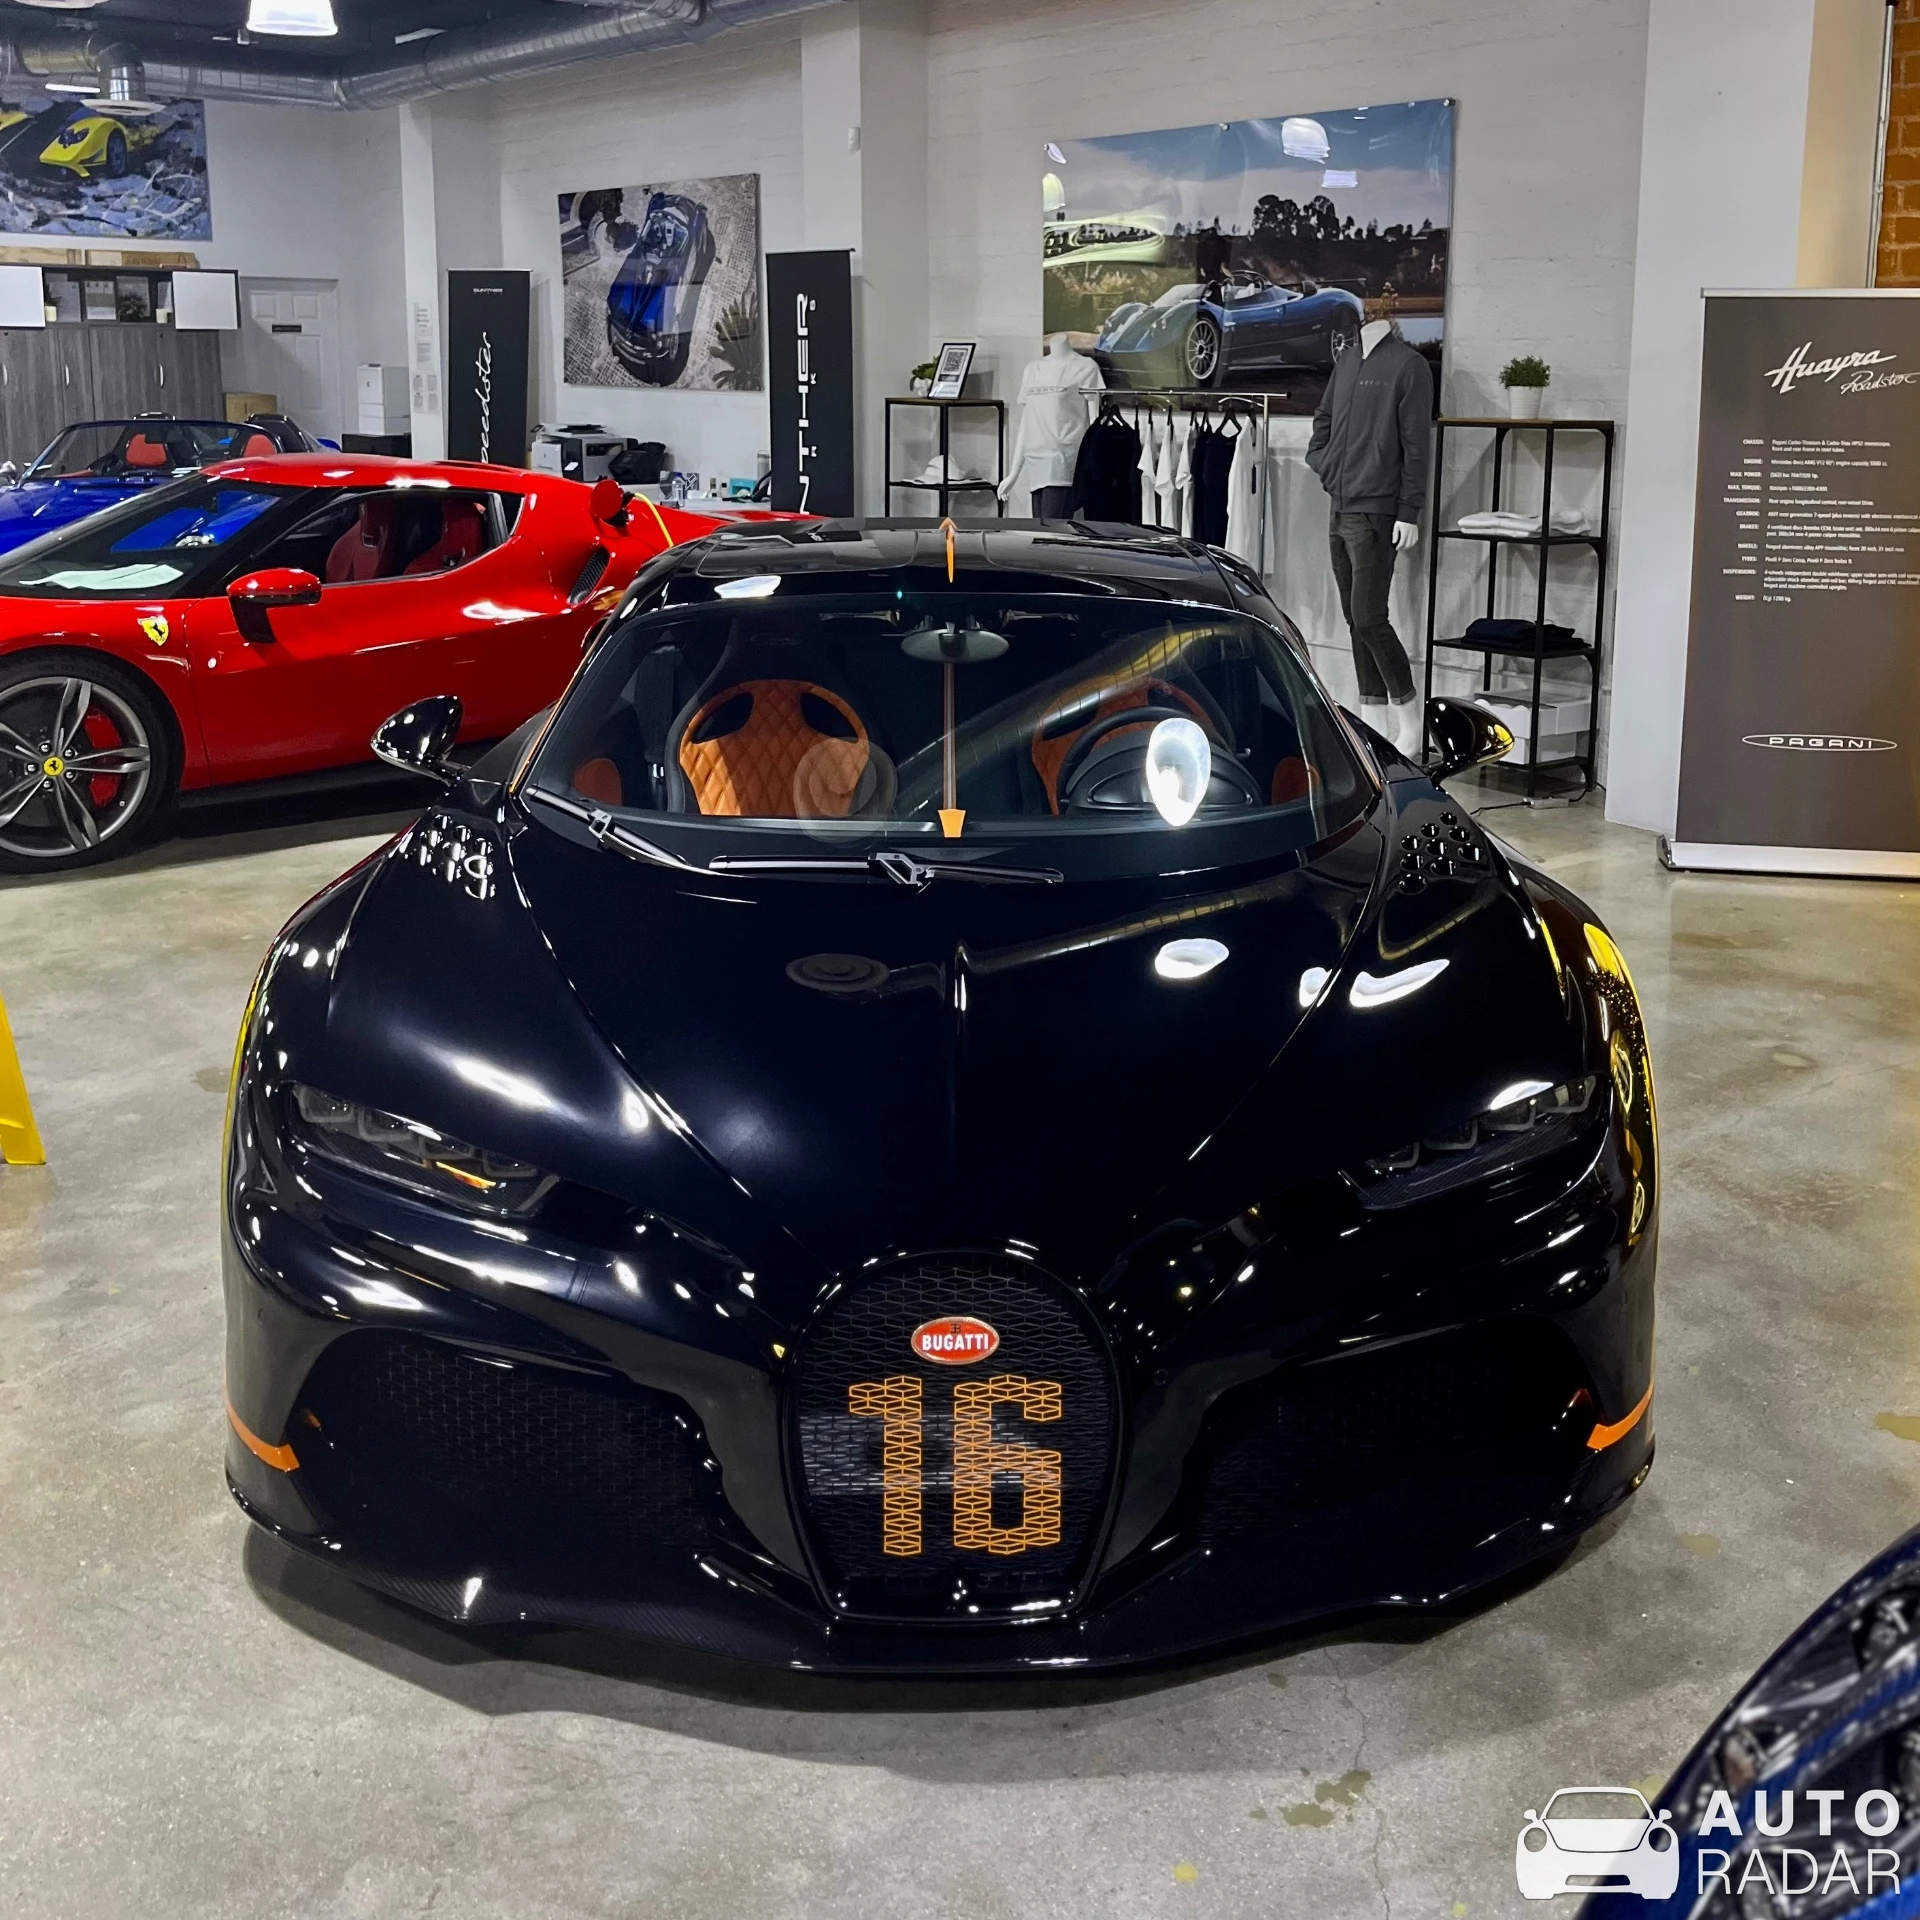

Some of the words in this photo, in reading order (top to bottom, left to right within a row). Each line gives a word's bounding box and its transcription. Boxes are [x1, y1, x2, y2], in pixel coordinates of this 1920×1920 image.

[1763, 341, 1897, 394] Huayra
[1840, 370, 1920, 395] Roadster
[796, 293, 810, 515] NTHER
[1768, 736, 1873, 749] PAGANI
[922, 1332, 989, 1351] BUGATTI
[848, 1374, 1062, 1557] 16
